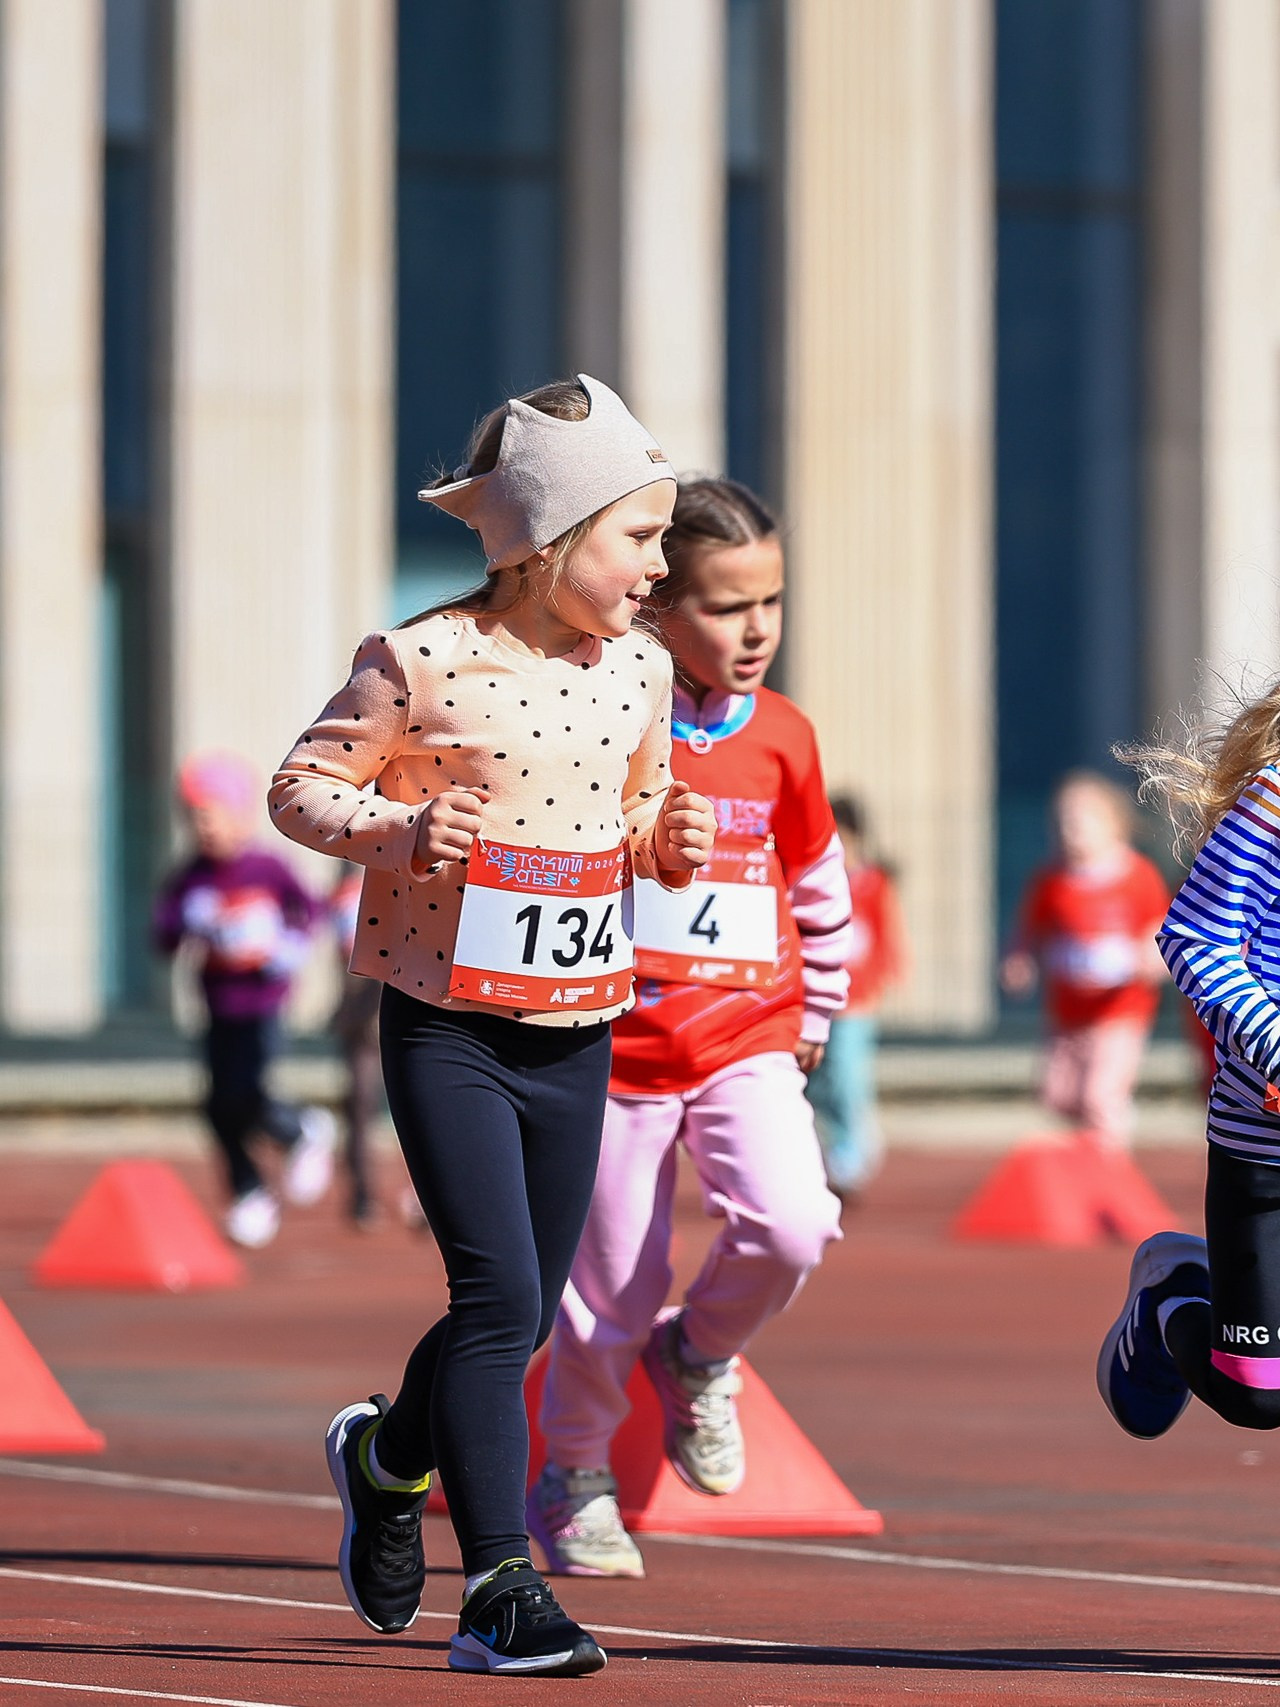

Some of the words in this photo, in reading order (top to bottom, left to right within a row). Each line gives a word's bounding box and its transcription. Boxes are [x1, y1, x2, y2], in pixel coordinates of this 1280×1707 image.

[486, 845, 583, 873] ДЕТСКИЙ
[499, 866, 568, 888] ЗАБЕГ
[689, 893, 720, 944] 4
[515, 903, 614, 968] 134
[1222, 1324, 1270, 1345] NRG
